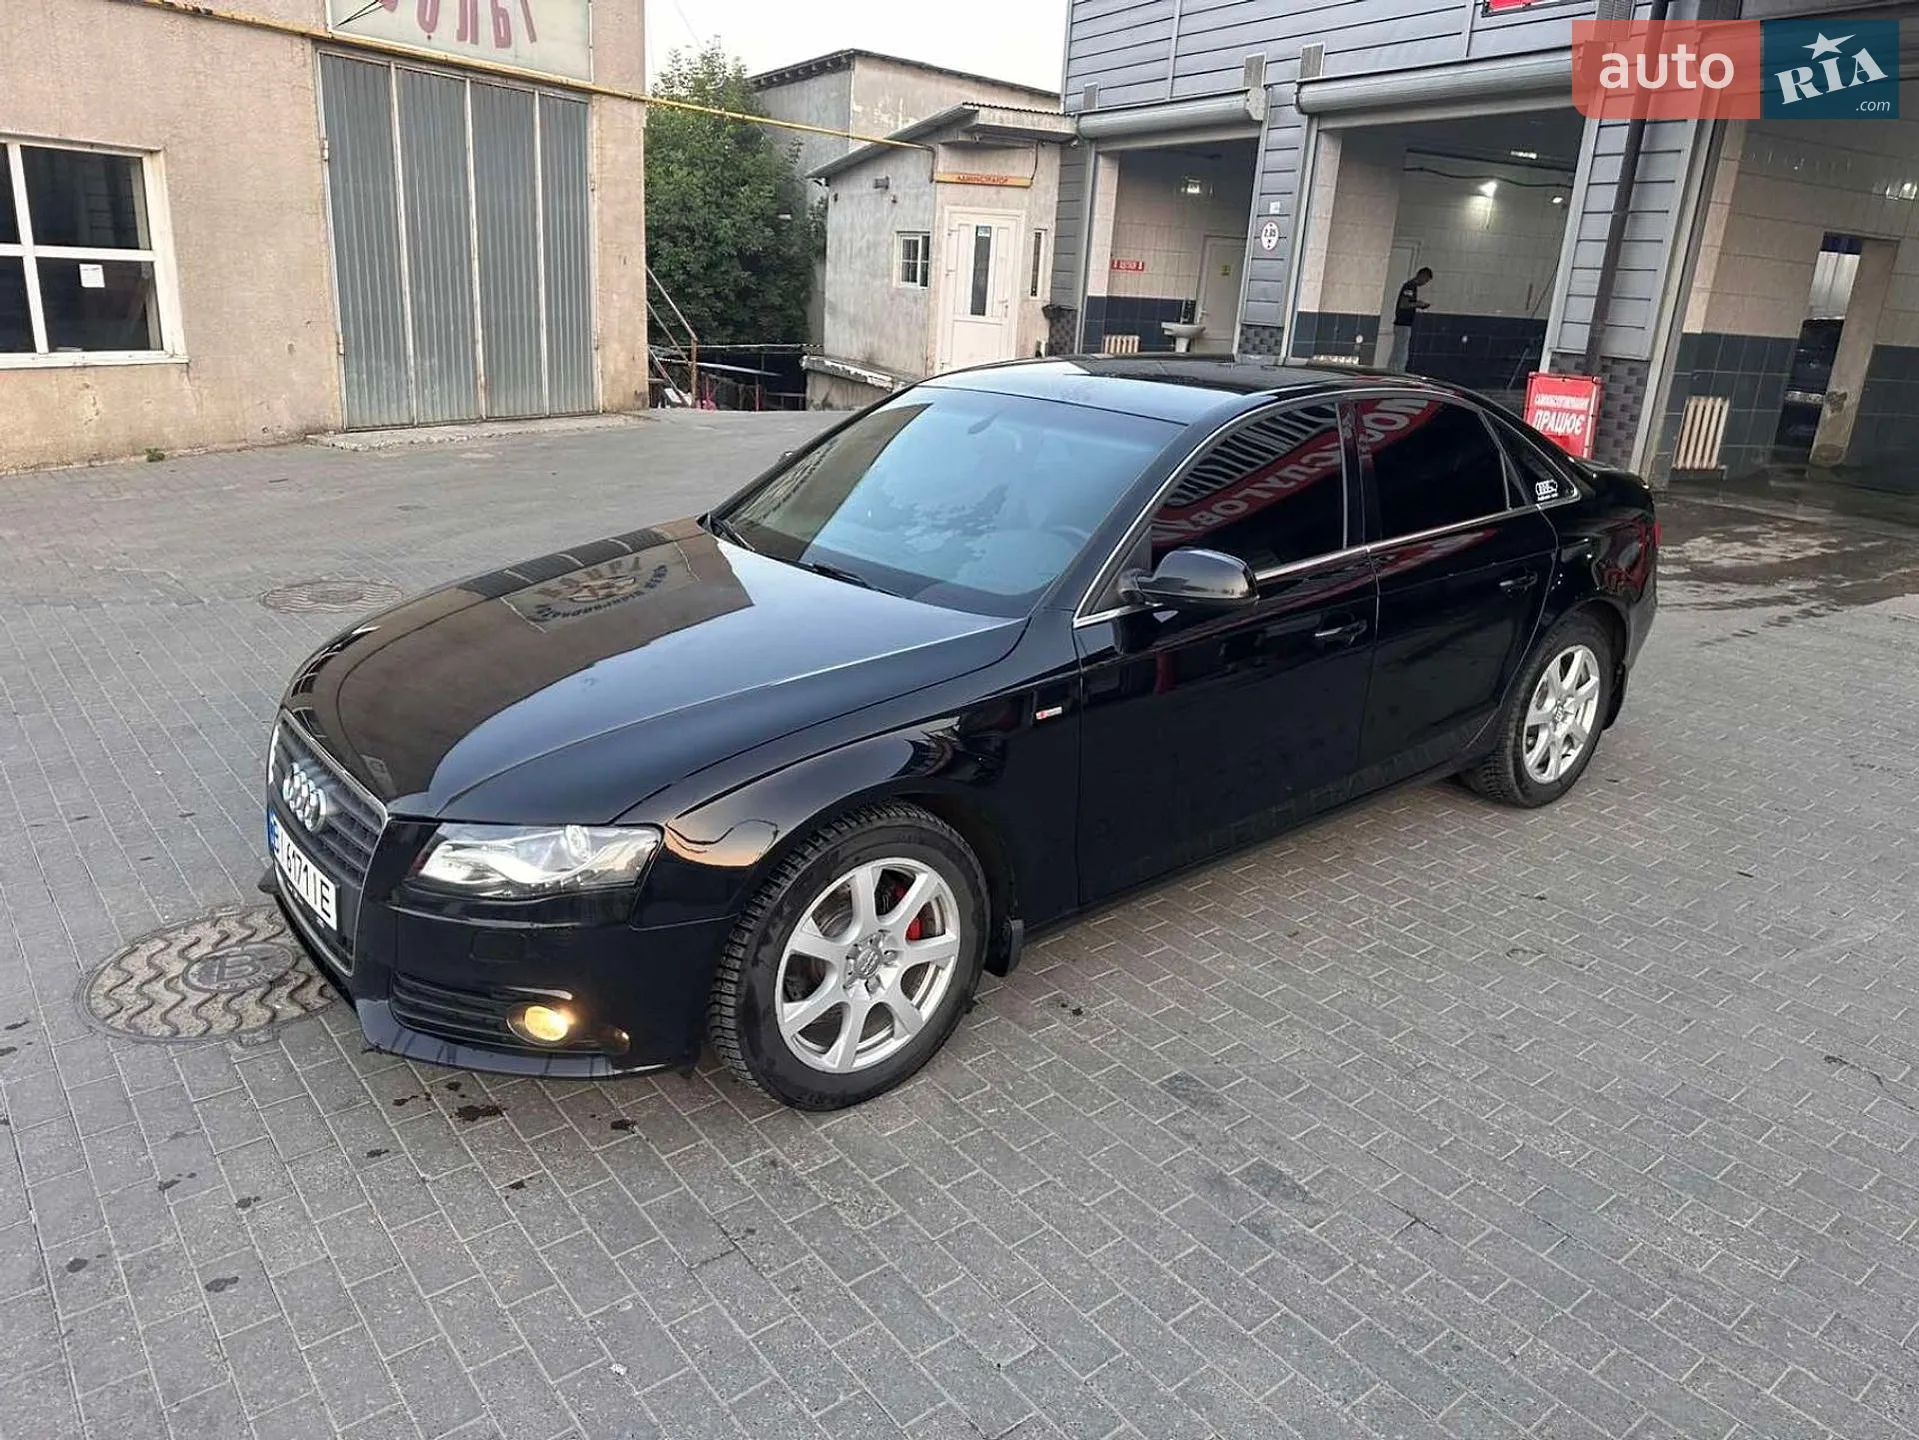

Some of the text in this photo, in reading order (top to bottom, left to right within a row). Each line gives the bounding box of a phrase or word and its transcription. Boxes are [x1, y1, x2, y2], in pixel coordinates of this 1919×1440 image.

[1532, 409, 1586, 435] ПРАЦЮЄ
[286, 843, 309, 897] 6171
[312, 871, 331, 919] IE
